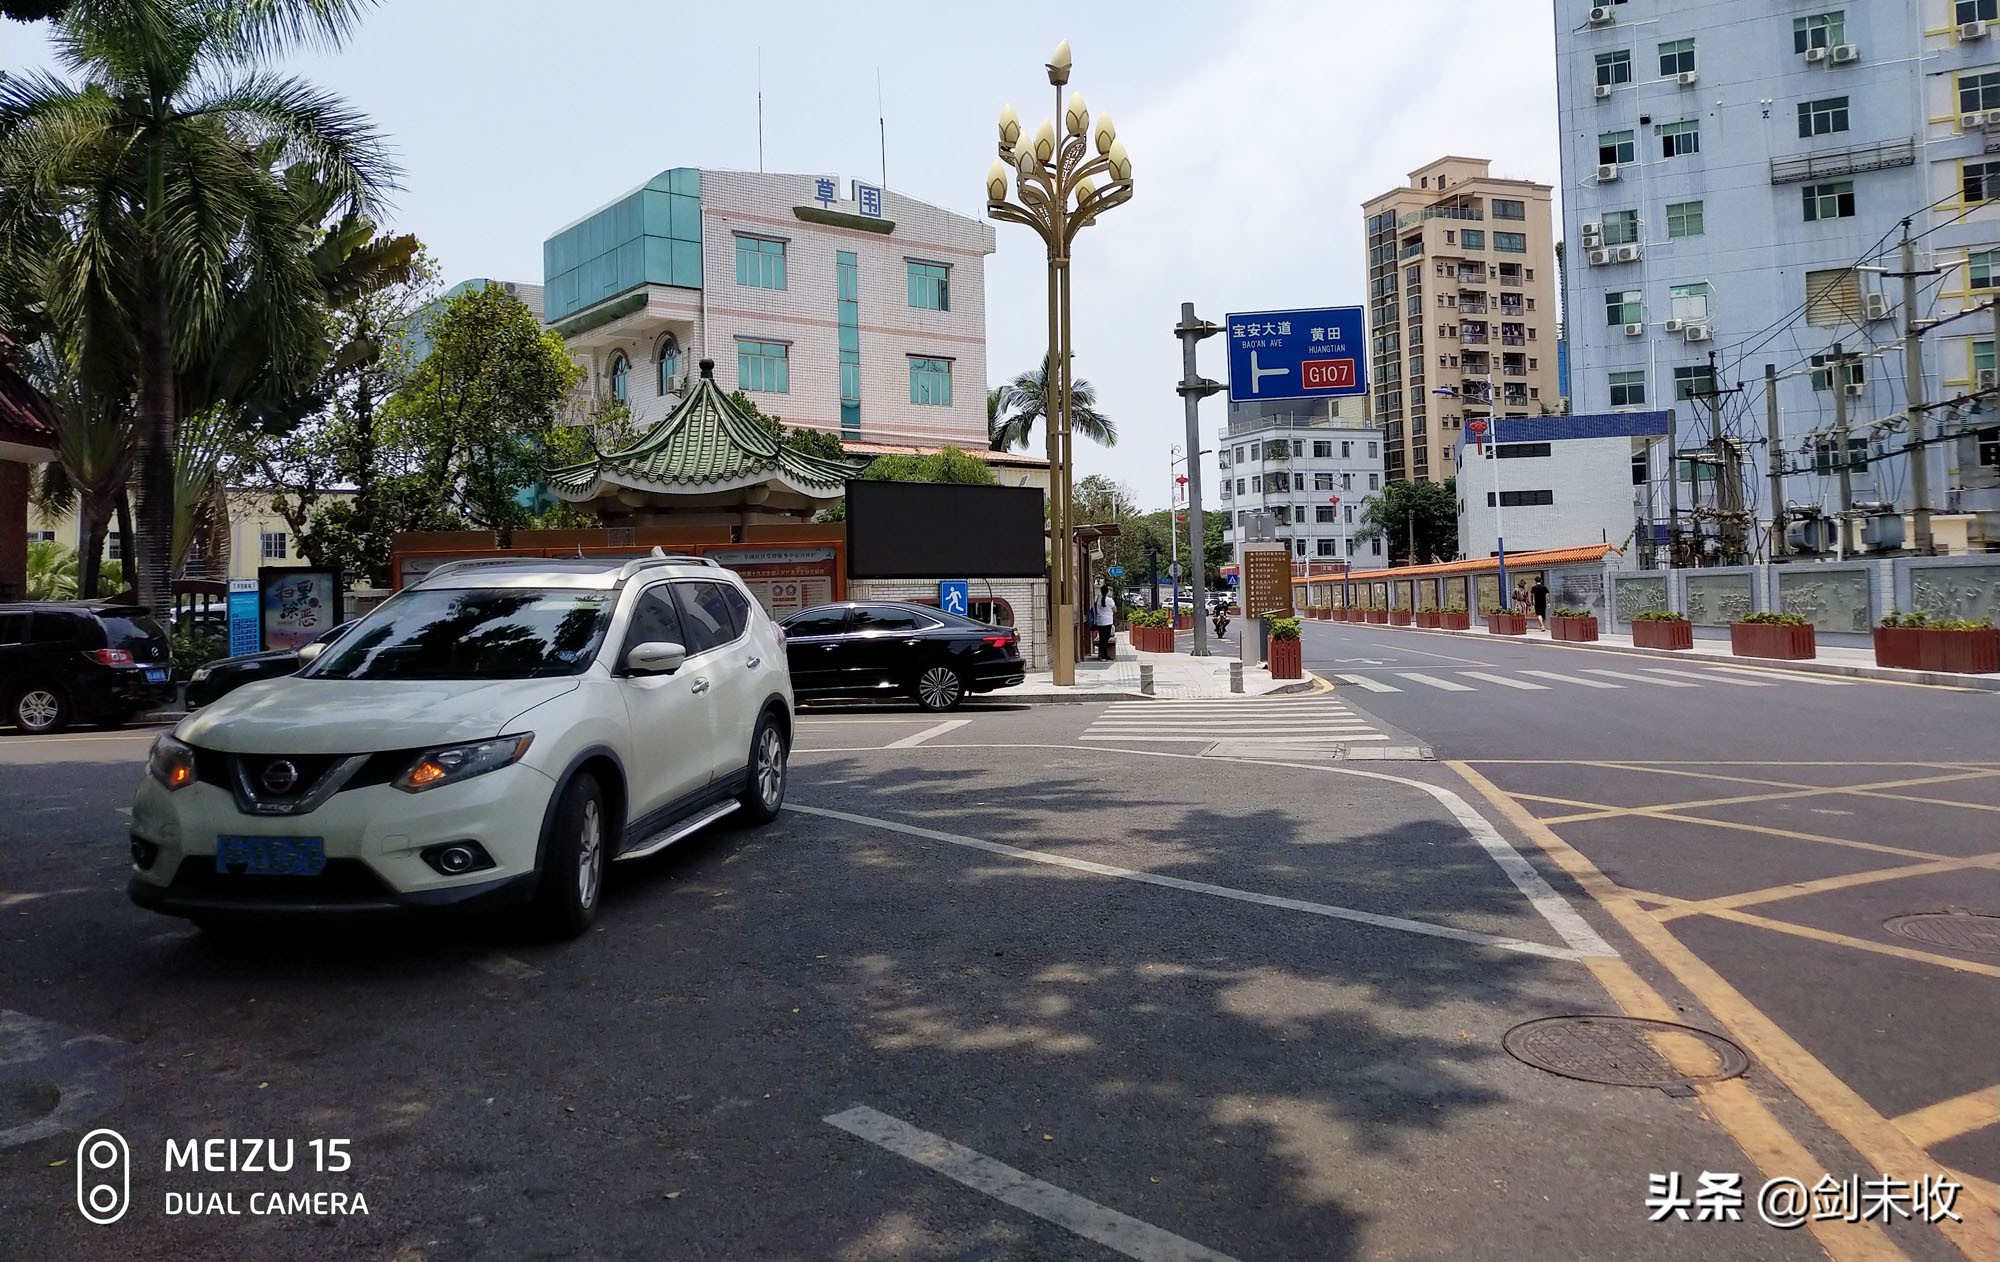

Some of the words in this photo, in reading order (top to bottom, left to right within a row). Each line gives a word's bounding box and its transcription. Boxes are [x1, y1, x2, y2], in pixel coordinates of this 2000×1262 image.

[814, 178, 882, 217] 草围
[1232, 321, 1292, 338] 宝安大道
[1310, 327, 1341, 341] 黄田
[1242, 340, 1266, 349] BAO'AN
[1270, 339, 1283, 347] AVE
[1308, 344, 1346, 354] HUANGTIAN
[1309, 365, 1348, 383] G107
